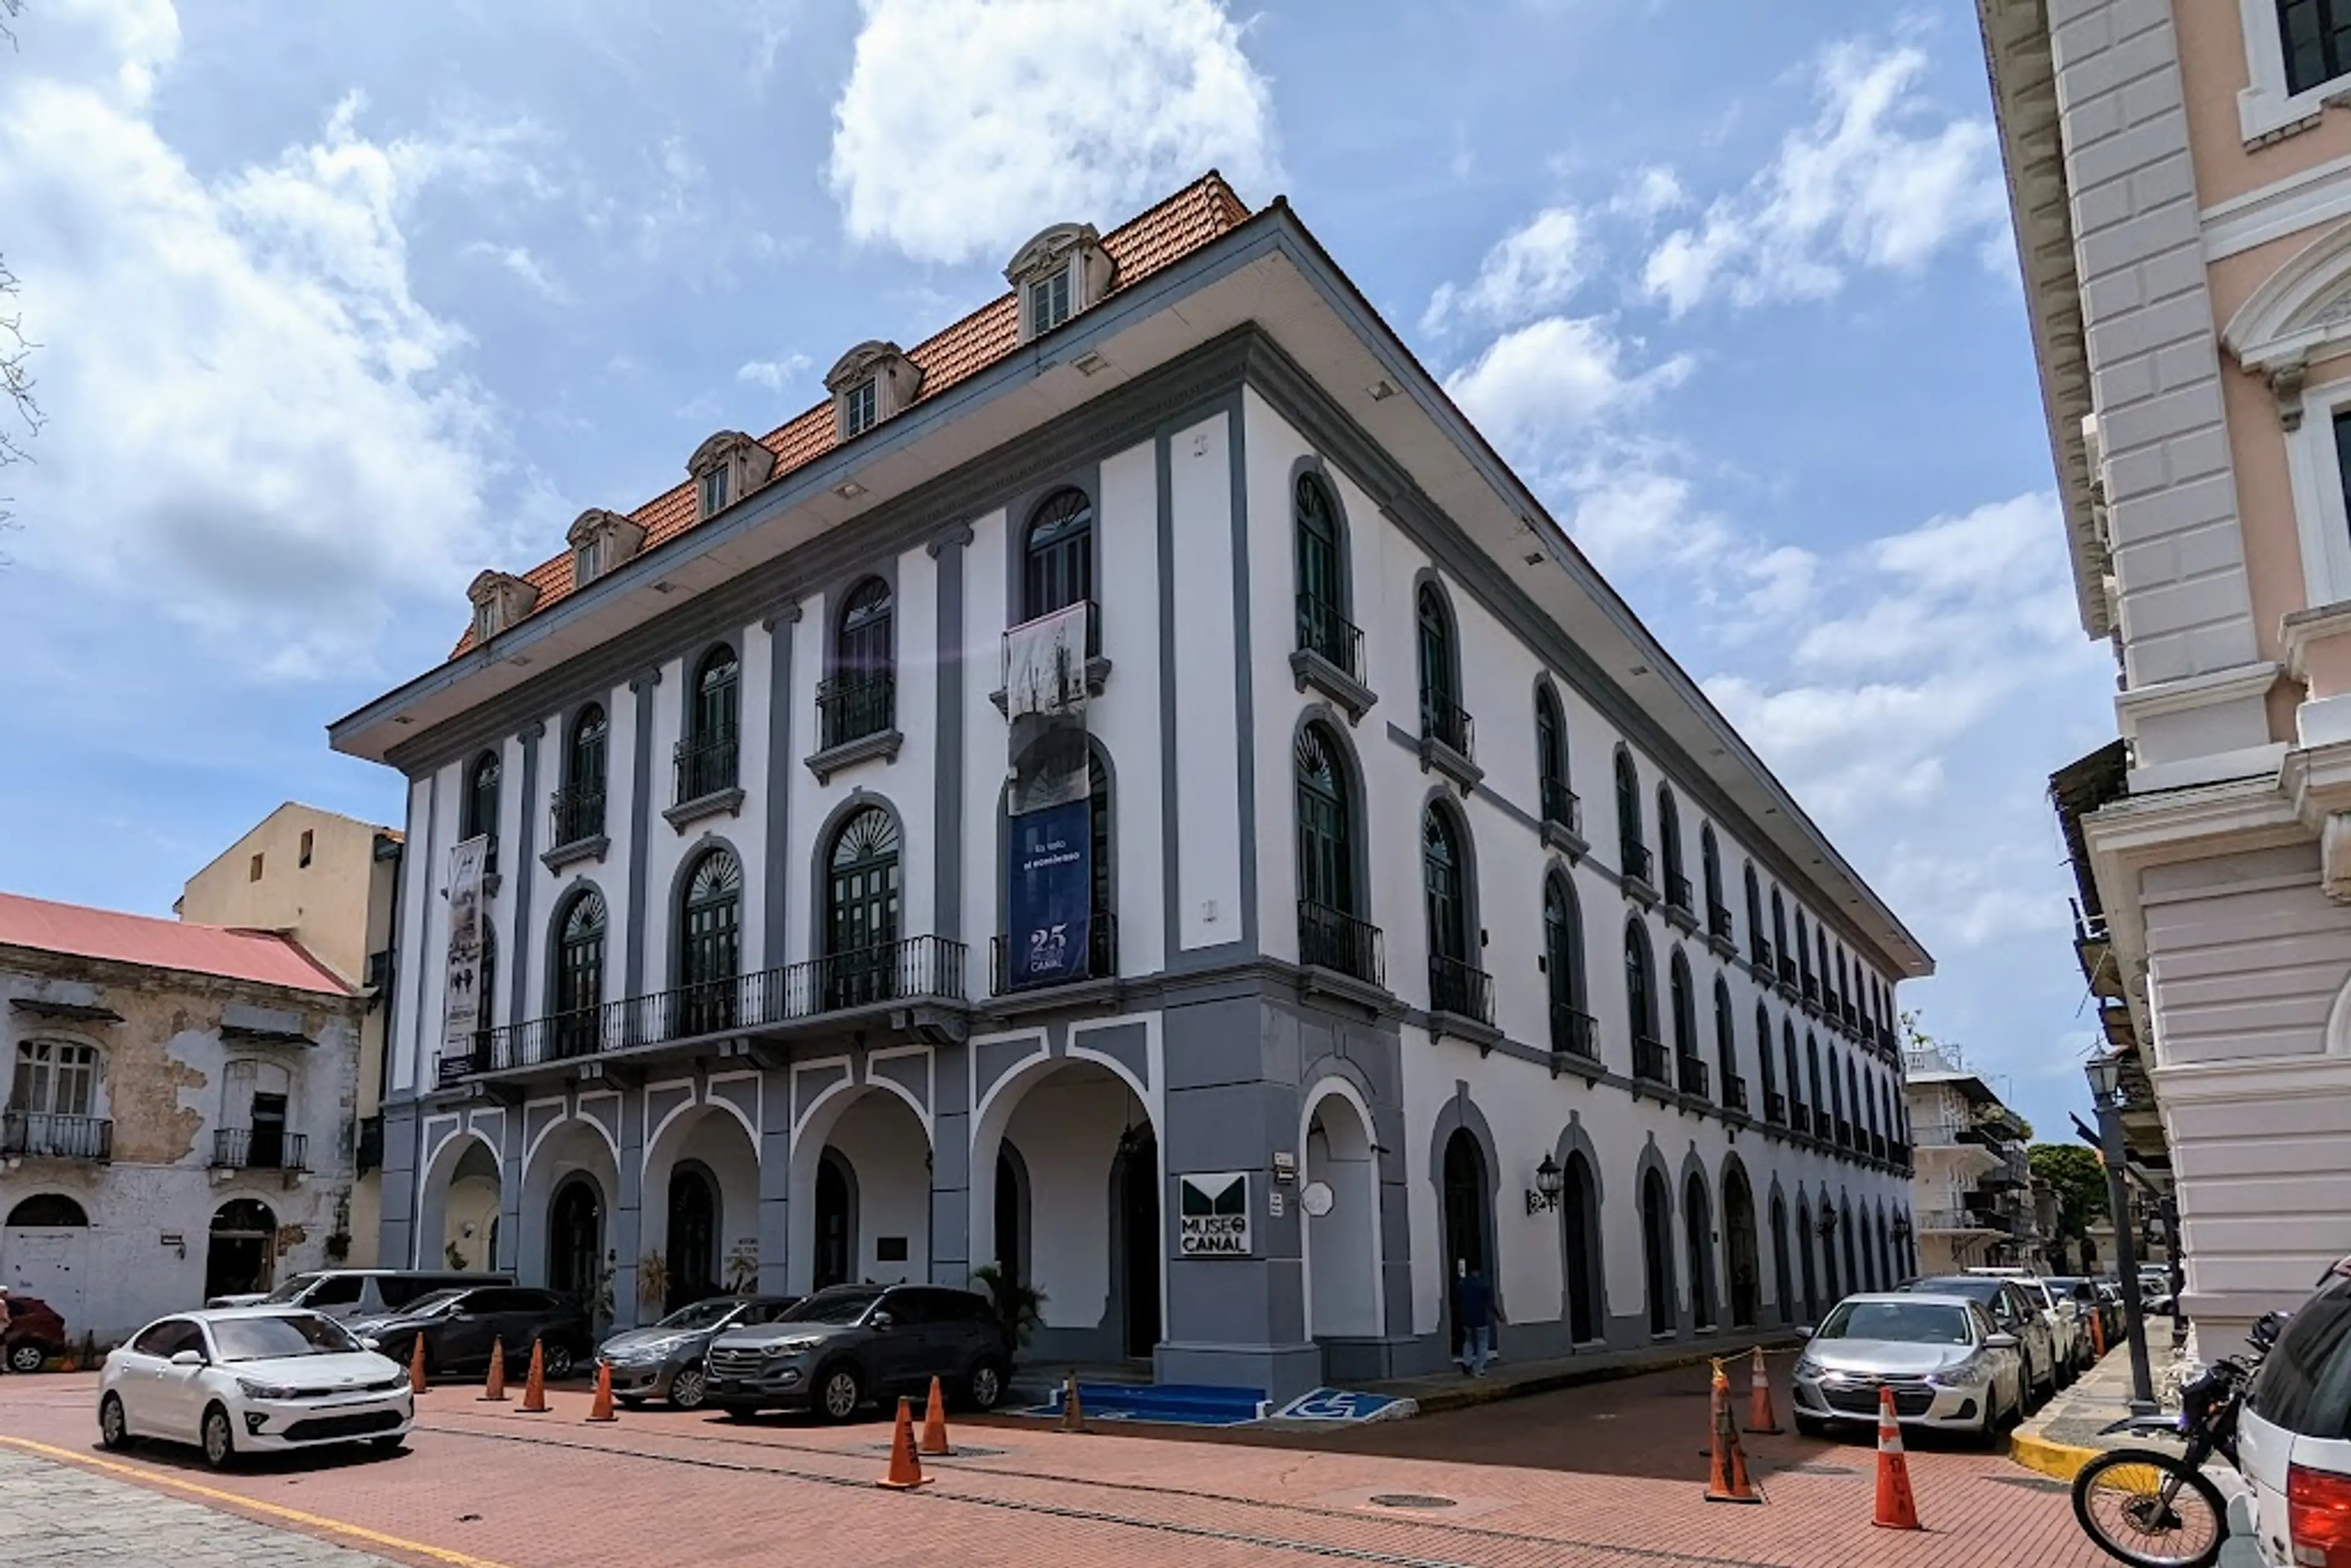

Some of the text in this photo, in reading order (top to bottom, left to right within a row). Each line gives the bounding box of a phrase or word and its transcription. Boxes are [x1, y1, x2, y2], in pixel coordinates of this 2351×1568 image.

[1030, 923, 1068, 953] 25
[1182, 1217, 1245, 1234] MUSEO
[1182, 1237, 1247, 1252] CANAL
